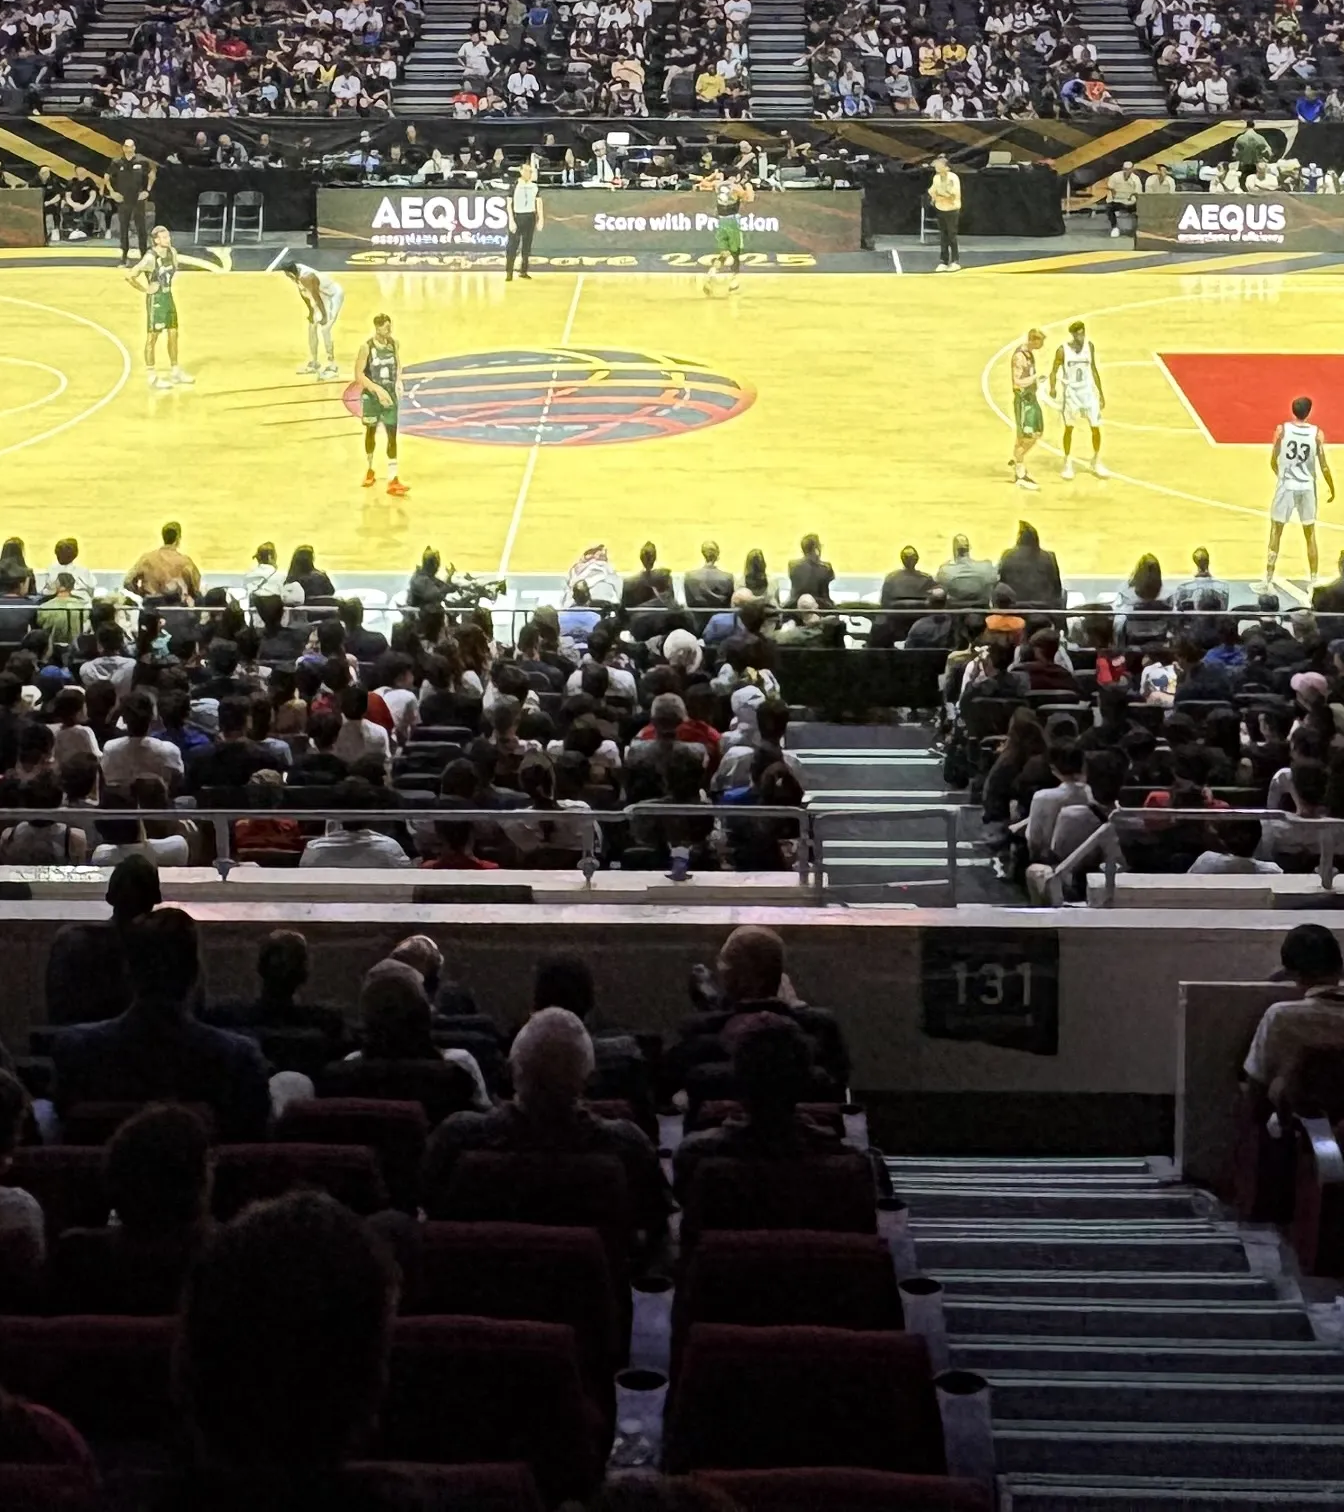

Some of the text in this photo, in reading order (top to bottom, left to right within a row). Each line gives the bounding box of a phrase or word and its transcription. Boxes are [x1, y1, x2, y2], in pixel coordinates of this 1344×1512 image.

[371, 196, 508, 232] AEQUS
[593, 214, 646, 231] Score
[649, 213, 691, 231] with
[1178, 204, 1286, 232] AEQUS
[658, 252, 817, 268] 2025
[1286, 440, 1311, 463] 33
[951, 961, 1033, 1007] 131
